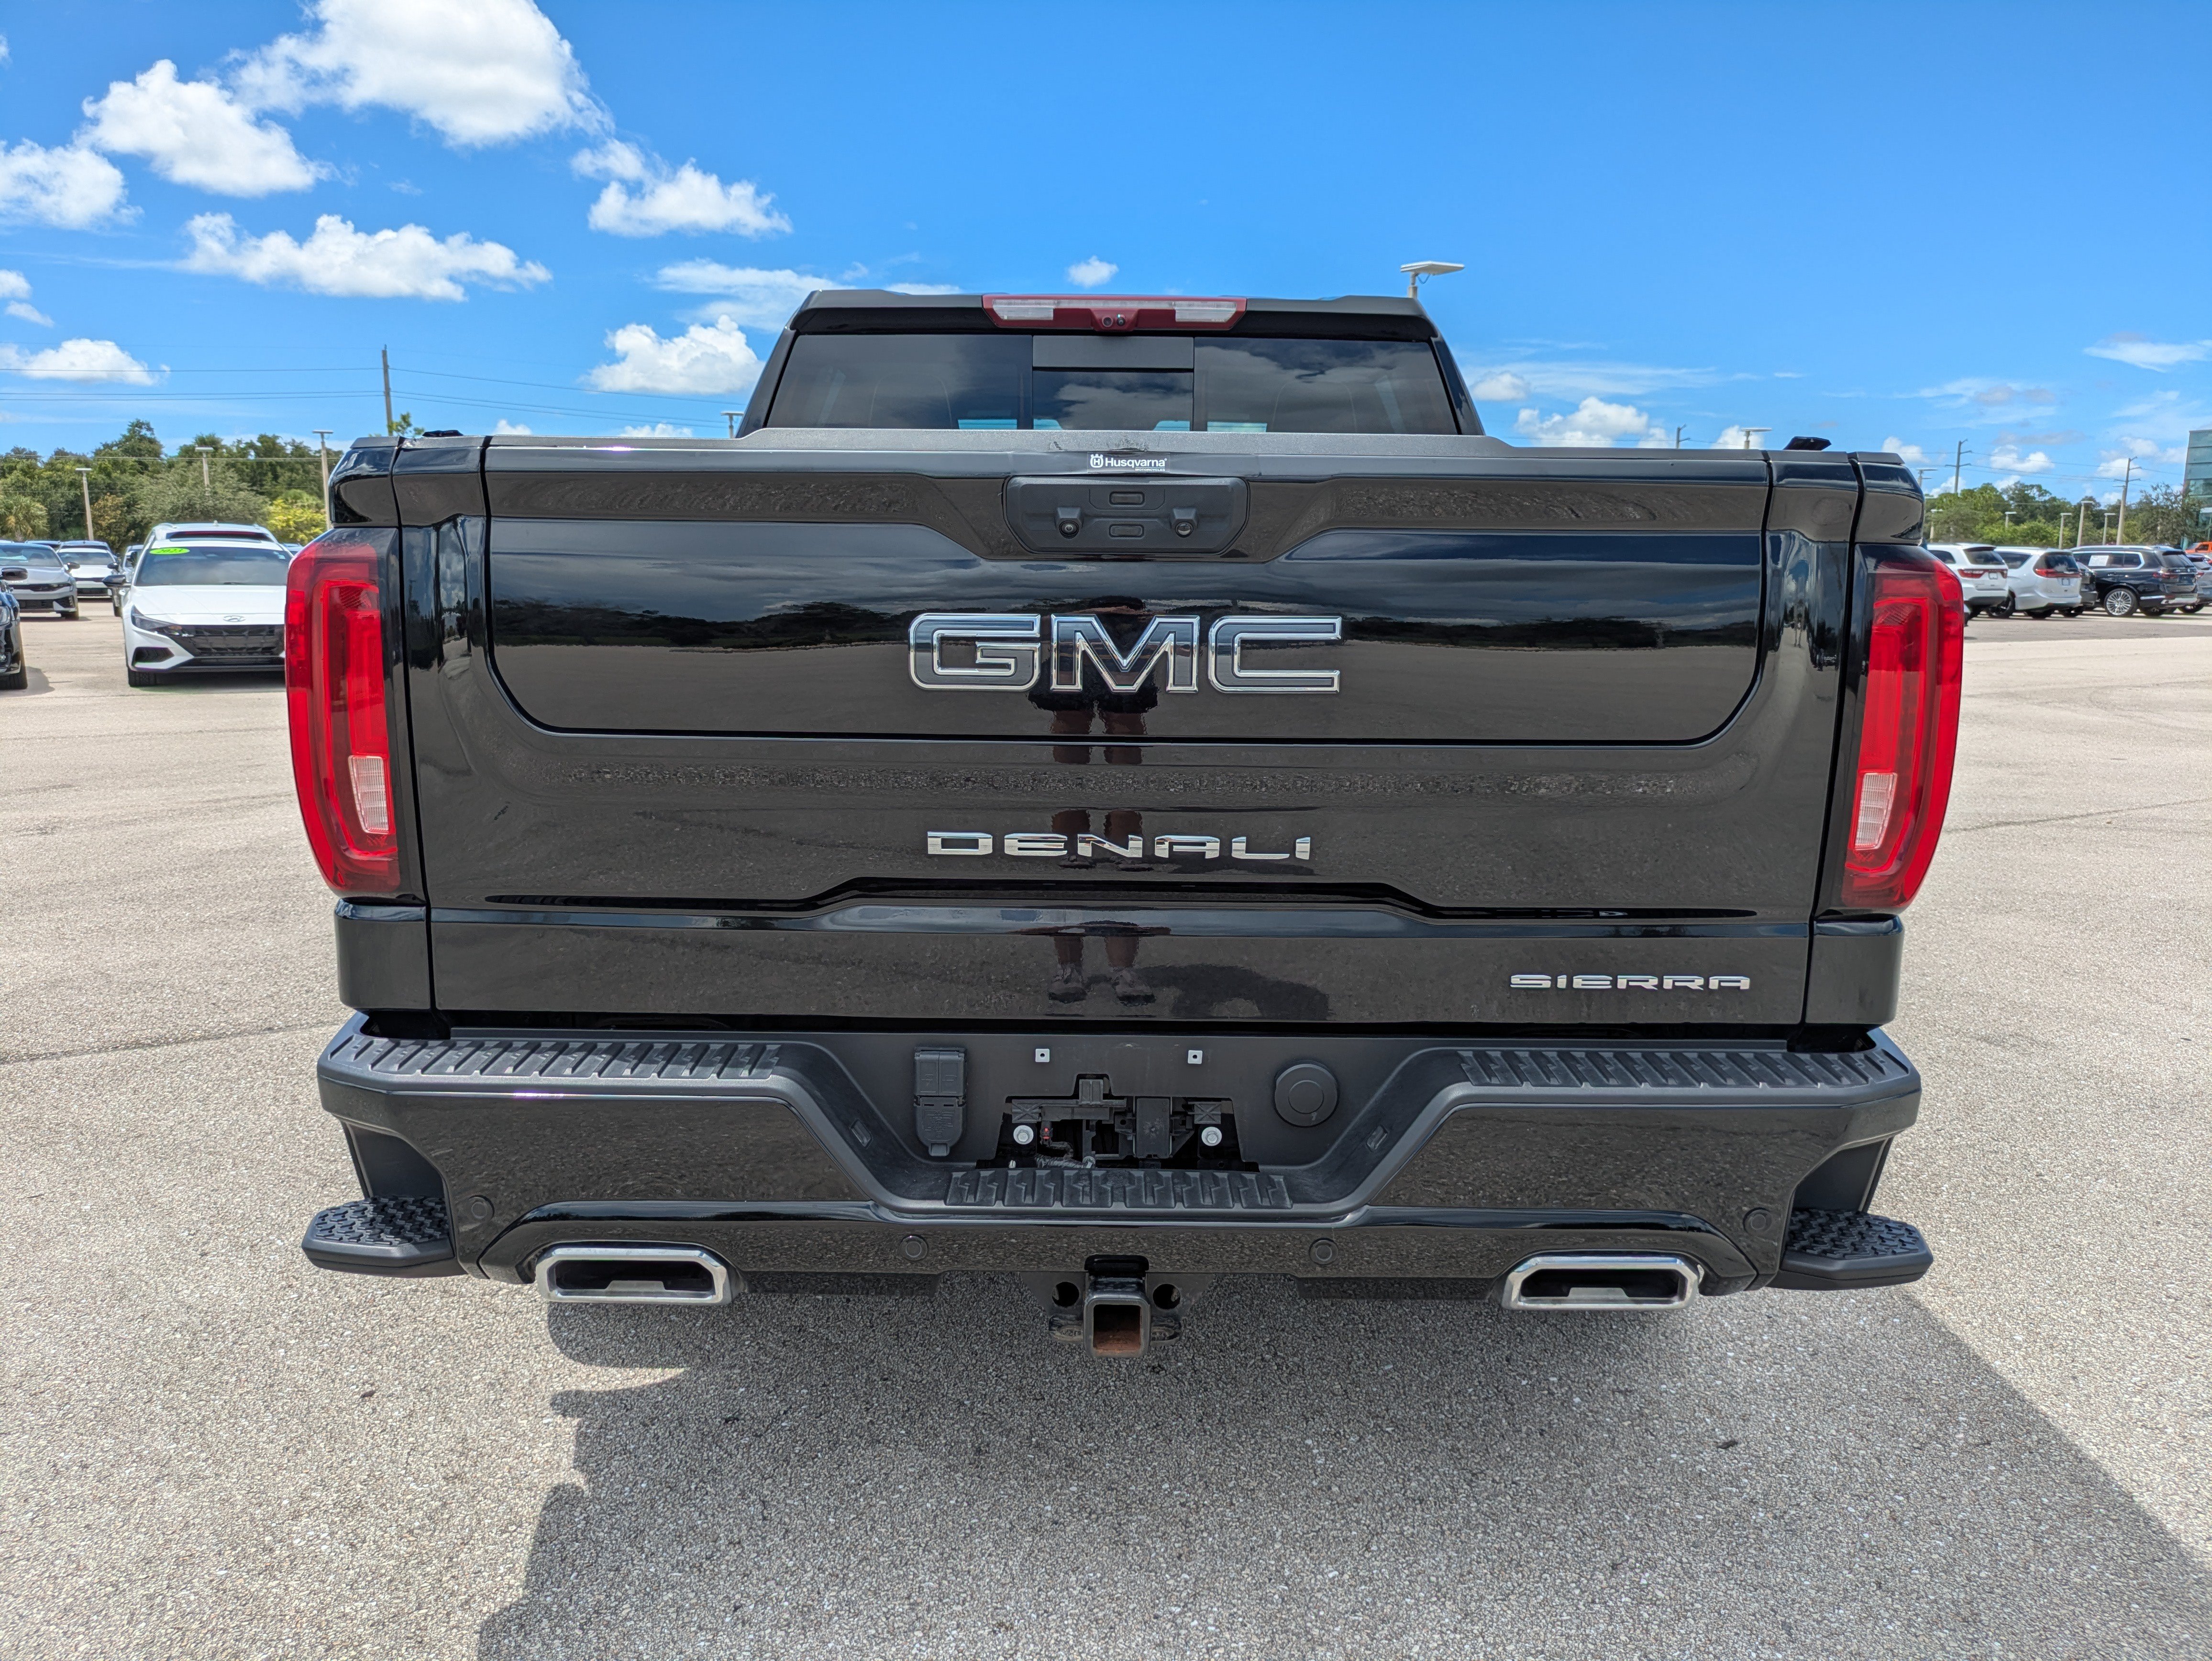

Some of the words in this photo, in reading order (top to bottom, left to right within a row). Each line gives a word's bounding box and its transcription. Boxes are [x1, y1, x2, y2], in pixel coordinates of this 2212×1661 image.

[908, 613, 1342, 694] GMC
[927, 831, 1311, 861] DENALI
[1510, 974, 1751, 991] SIERRA
